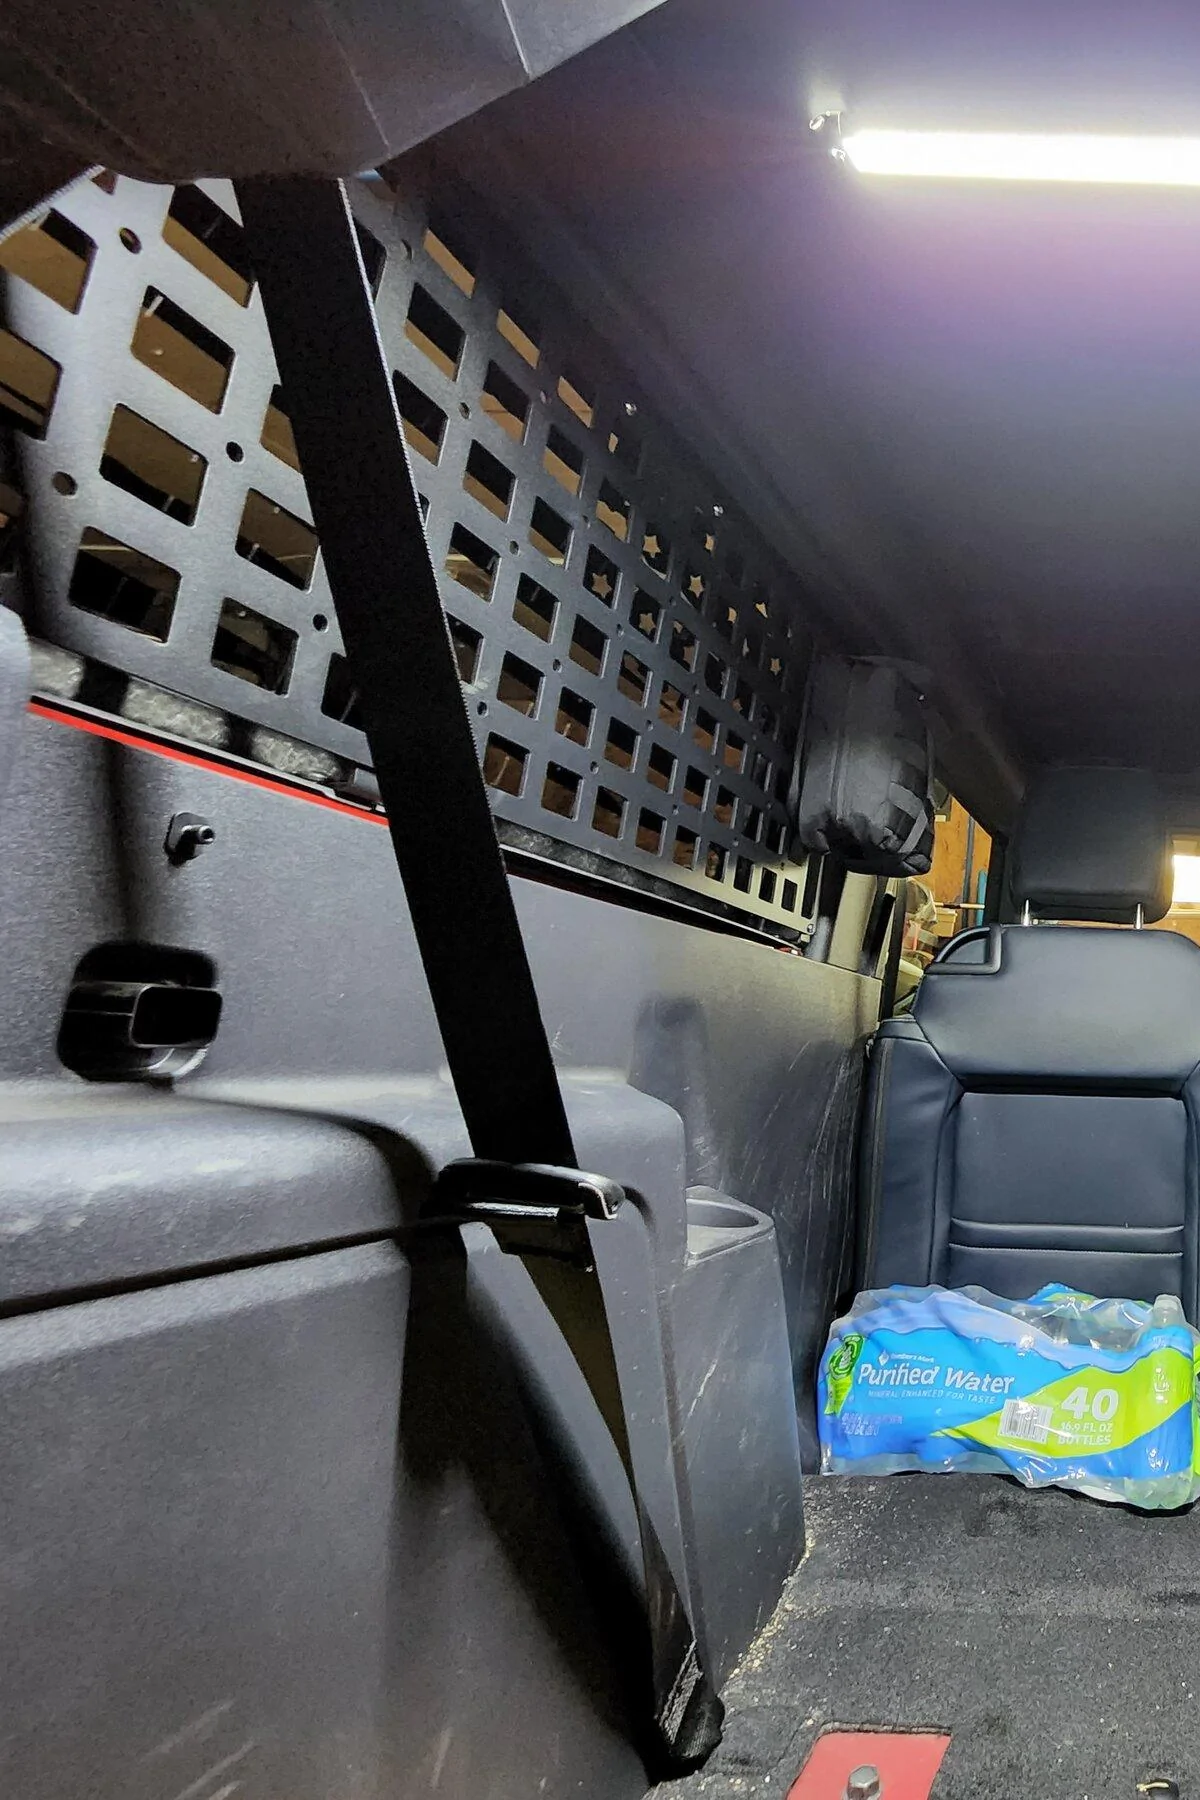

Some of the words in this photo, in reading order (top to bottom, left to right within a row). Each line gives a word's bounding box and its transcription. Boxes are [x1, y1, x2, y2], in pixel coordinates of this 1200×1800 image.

[858, 1363, 940, 1386] Purified
[944, 1367, 1015, 1394] Water
[868, 1389, 898, 1399] MINERAL
[901, 1389, 944, 1398] ENHANCED
[947, 1391, 965, 1400] FOR
[967, 1394, 996, 1404] TASTE
[1060, 1386, 1119, 1422] 40
[1060, 1421, 1081, 1433] 16.9
[1099, 1422, 1114, 1433] OZ
[1057, 1434, 1112, 1446] BOTTLES
